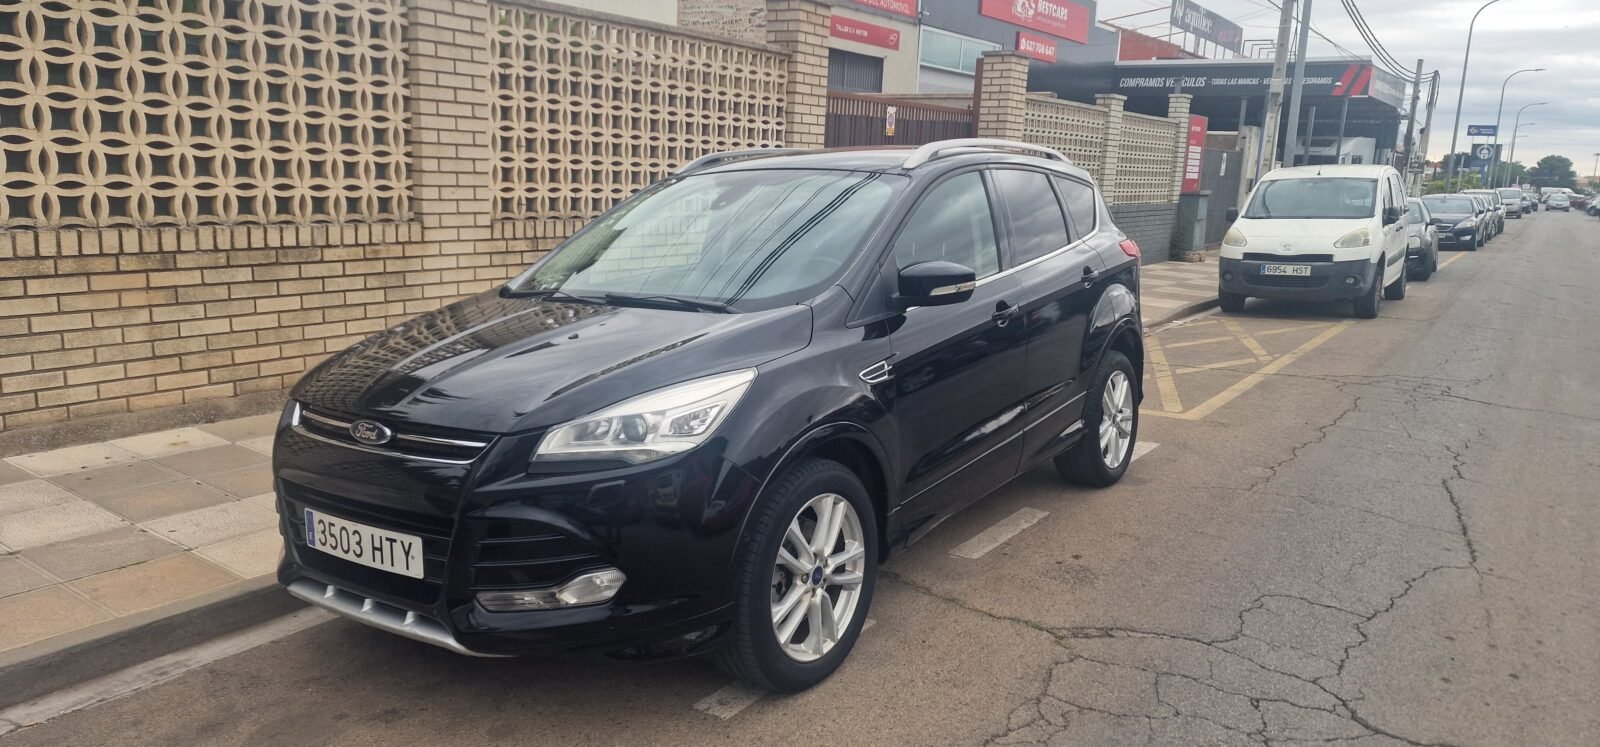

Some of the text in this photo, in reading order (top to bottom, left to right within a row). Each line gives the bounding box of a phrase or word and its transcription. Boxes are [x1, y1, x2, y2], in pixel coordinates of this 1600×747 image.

[1037, 0, 1069, 21] BESTCARS
[1120, 77, 1165, 88] COMPRAMOS
[1166, 75, 1207, 88] VEÍCULOS
[1266, 265, 1309, 275] 6954 HST
[355, 422, 377, 440] Ford
[317, 518, 364, 559] 3503
[370, 533, 413, 571] HTY
